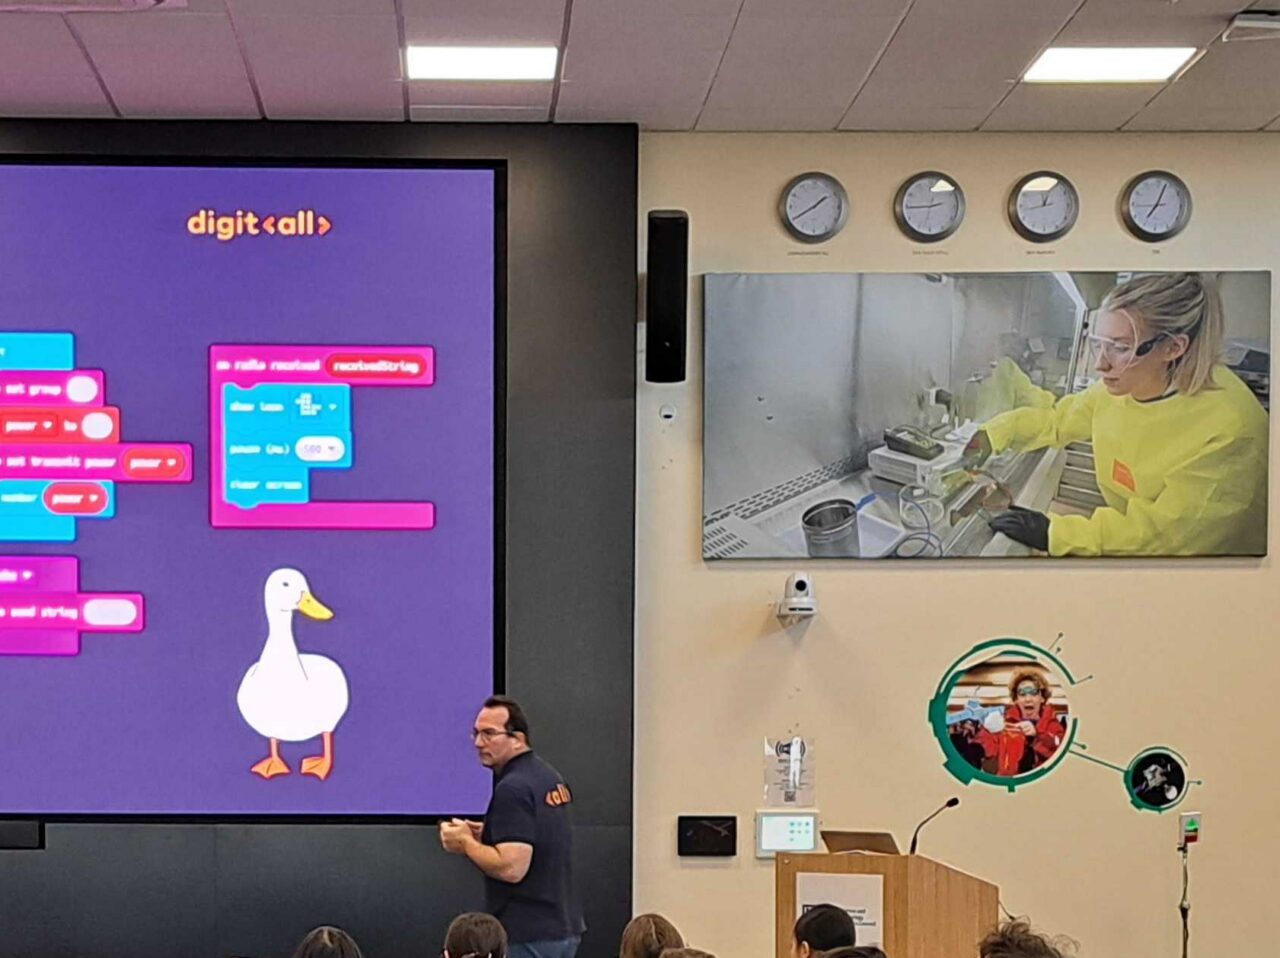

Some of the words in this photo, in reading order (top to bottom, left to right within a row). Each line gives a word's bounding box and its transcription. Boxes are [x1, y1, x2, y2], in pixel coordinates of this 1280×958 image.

[6, 383, 25, 395] set
[29, 385, 62, 397] group
[41, 605, 78, 620] string
